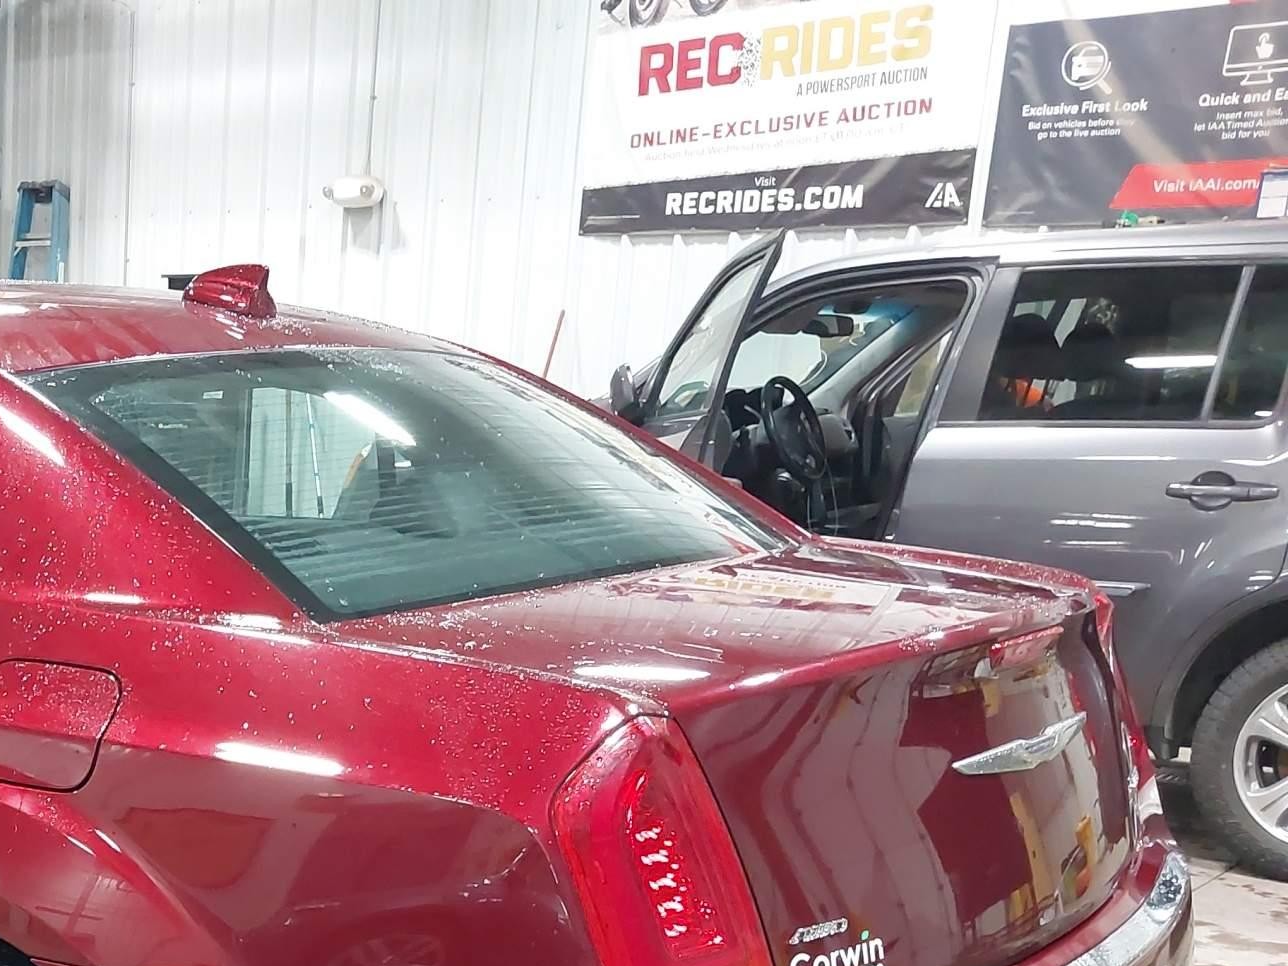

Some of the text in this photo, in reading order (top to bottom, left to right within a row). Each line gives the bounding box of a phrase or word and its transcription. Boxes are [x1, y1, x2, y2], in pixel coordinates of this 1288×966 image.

[638, 4, 934, 96] REC RIDES
[796, 66, 928, 97] A POWERSPORT AUCTION
[1198, 93, 1240, 106] Quick
[1243, 91, 1271, 102] and
[1021, 98, 1148, 117] Exclusive First Look
[1216, 111, 1241, 120] Insert
[1244, 110, 1264, 118] max
[630, 110, 829, 149] ONLINE-EXCLUSIVE
[837, 98, 933, 125] AUCTION
[1028, 121, 1041, 130] Bid
[1054, 120, 1087, 129] vehicles
[1088, 119, 1114, 127] before
[1193, 123, 1205, 131] let
[1037, 132, 1048, 141] go
[1059, 129, 1072, 137] the
[1074, 128, 1089, 137] live
[1090, 128, 1121, 136] auction
[1221, 129, 1271, 140] bid for you
[754, 176, 776, 187] Visit
[1153, 179, 1185, 192] Visit
[665, 185, 864, 216] RECRIDES.COM
